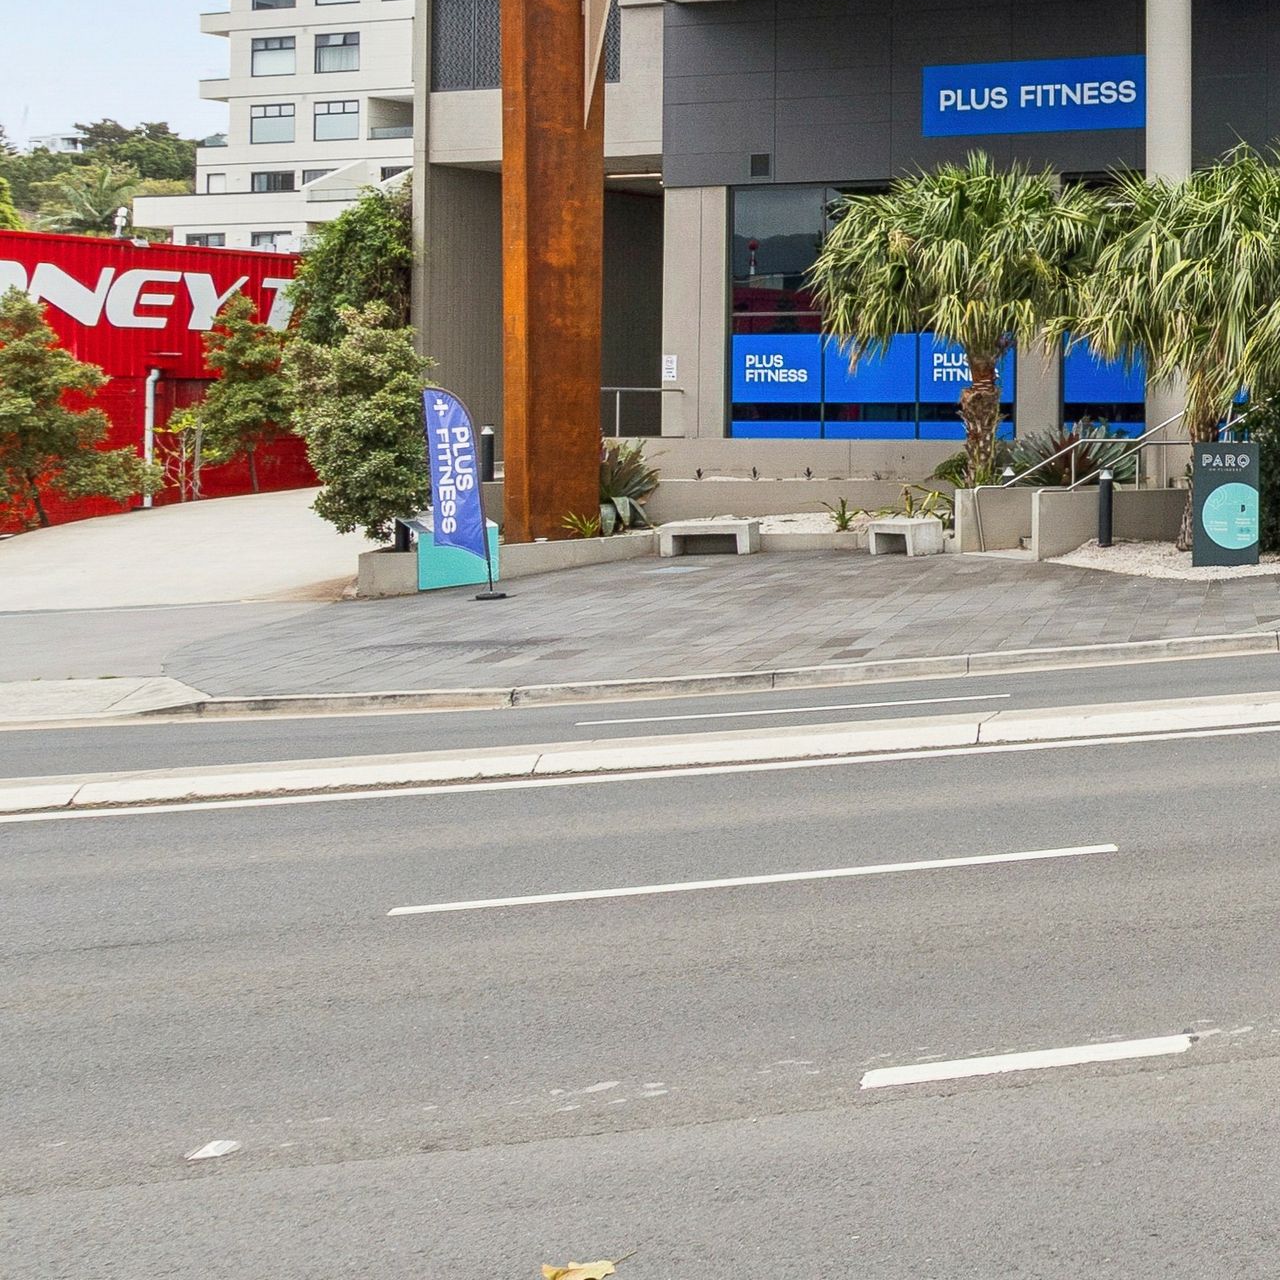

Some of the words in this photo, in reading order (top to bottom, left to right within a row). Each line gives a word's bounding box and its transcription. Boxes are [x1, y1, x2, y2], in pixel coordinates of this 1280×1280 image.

[939, 87, 1008, 112] PLUS
[1020, 80, 1137, 108] FITNESS
[0, 260, 249, 330] NEY
[745, 354, 784, 368] PLUS
[745, 369, 808, 382] FITNESS
[452, 426, 474, 492] PLUS
[1202, 454, 1250, 468] PARQ
[436, 428, 457, 534] FITNESS
